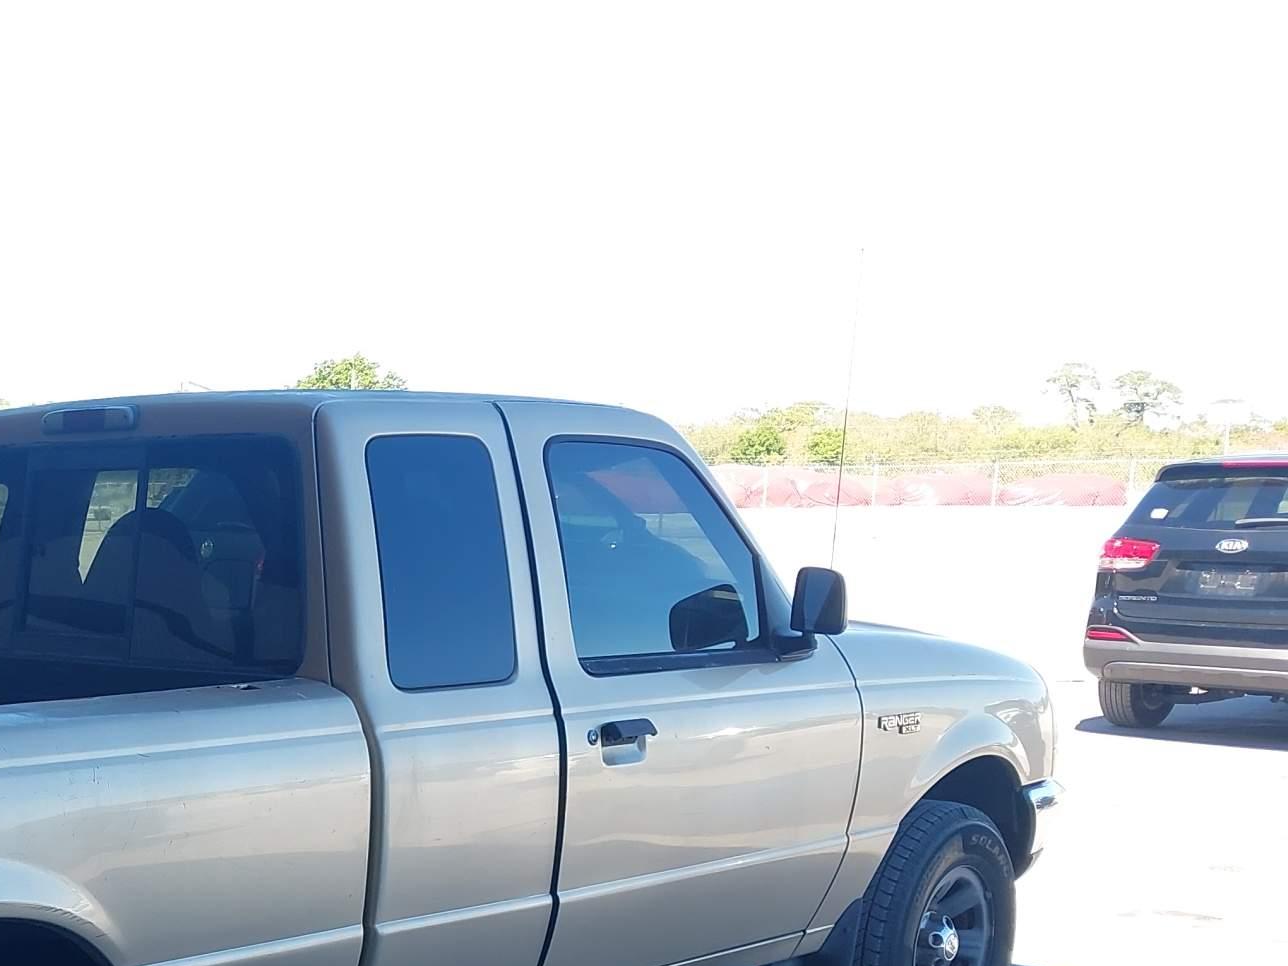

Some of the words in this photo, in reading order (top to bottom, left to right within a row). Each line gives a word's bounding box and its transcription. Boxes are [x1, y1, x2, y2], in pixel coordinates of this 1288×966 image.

[1218, 540, 1246, 551] KIA
[879, 712, 920, 731] RANGER
[902, 725, 920, 734] XLT
